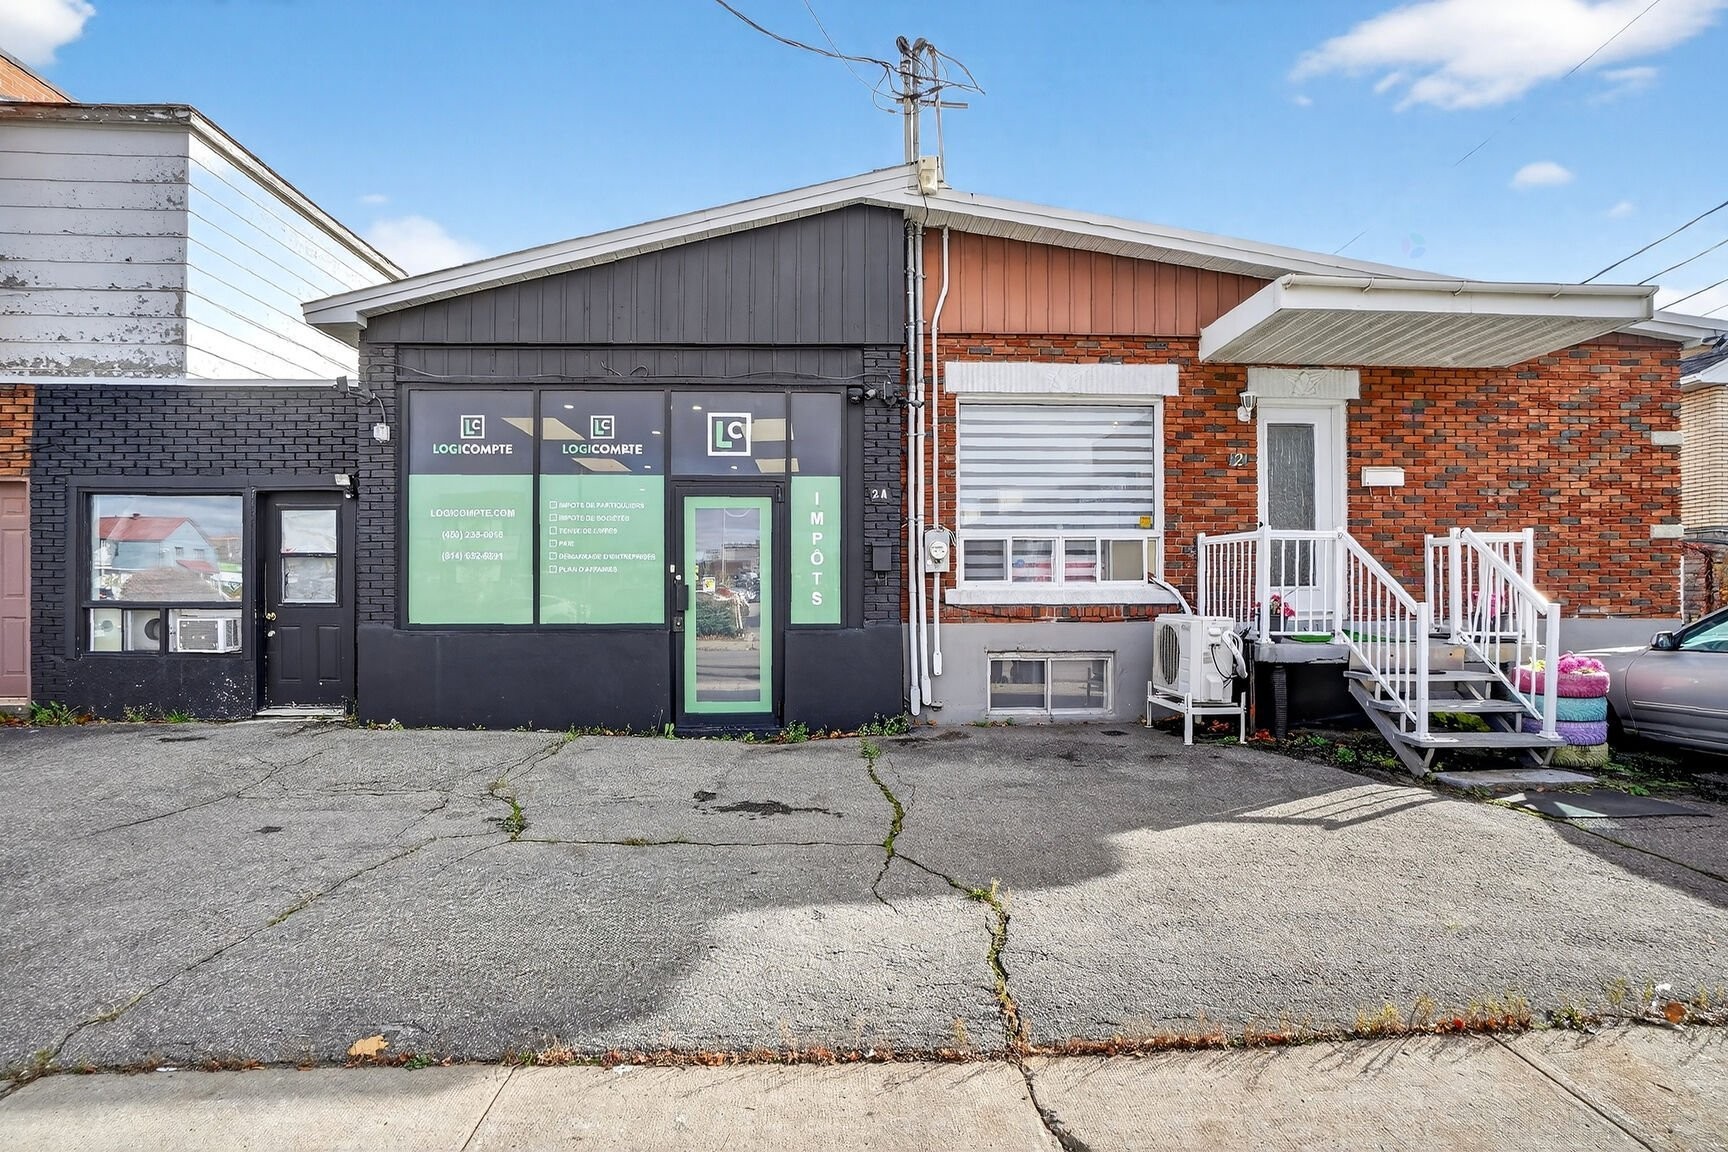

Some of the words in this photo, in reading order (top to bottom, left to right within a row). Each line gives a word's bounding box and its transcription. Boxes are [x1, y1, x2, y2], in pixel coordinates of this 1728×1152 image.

[464, 419, 481, 435] LC
[594, 419, 611, 435] LC
[715, 420, 745, 449] LC
[432, 443, 513, 455] LOGICOMPTE
[562, 443, 643, 455] LOGICOMPTE
[871, 488, 888, 500] 2A
[810, 491, 824, 606] IMPÔTS
